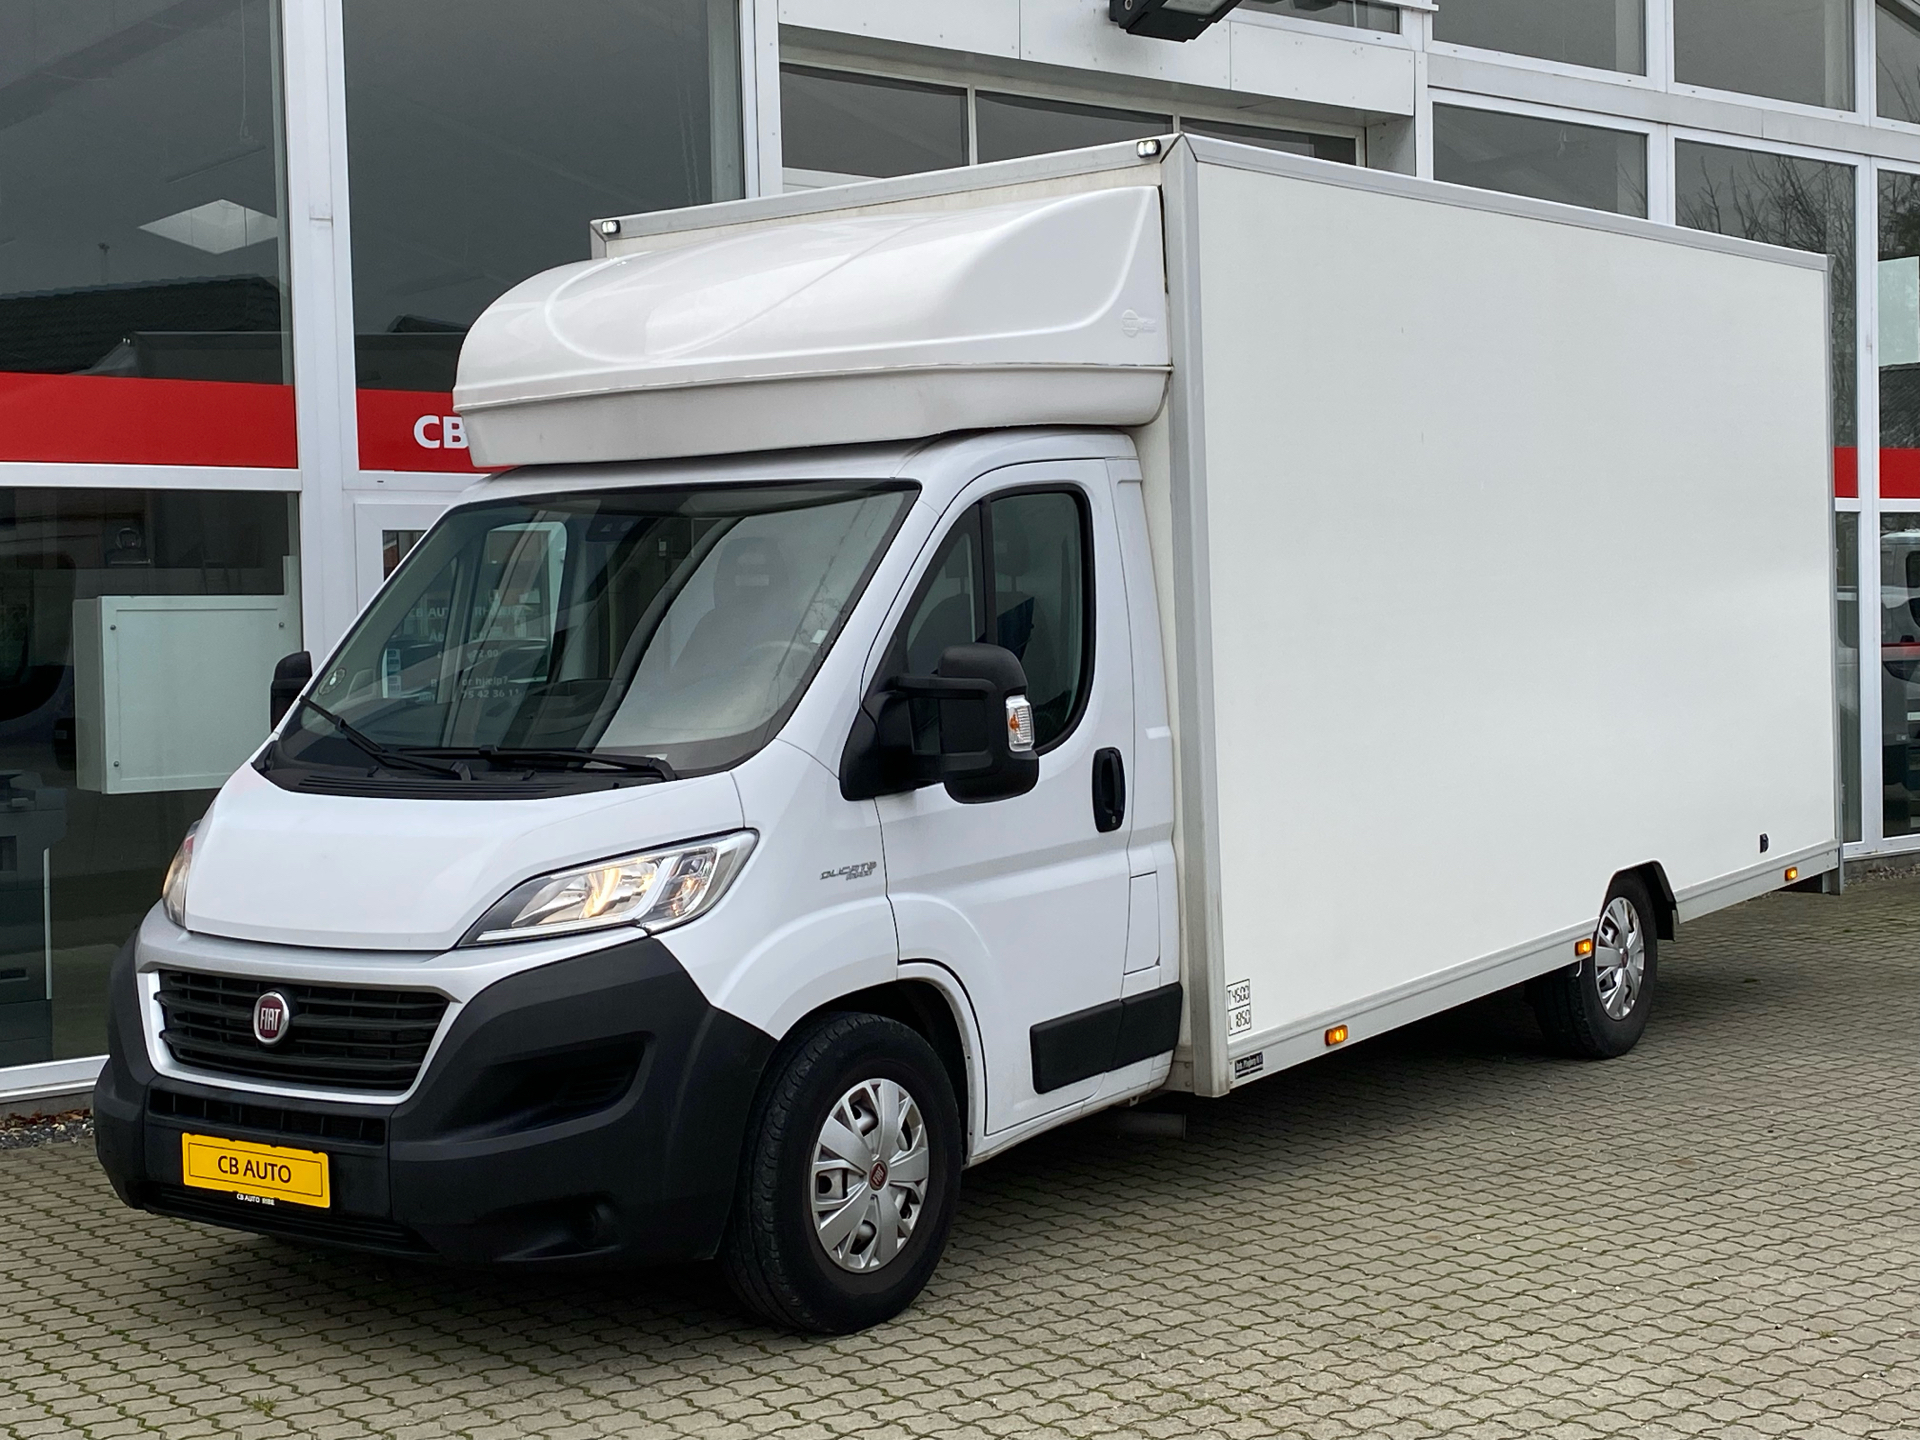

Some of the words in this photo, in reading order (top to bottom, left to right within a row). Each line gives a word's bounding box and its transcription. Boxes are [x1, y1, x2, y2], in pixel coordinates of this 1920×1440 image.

[414, 415, 469, 448] CB
[260, 1007, 281, 1031] FIAT
[217, 1156, 239, 1175] CB
[243, 1159, 291, 1183] AUTO
